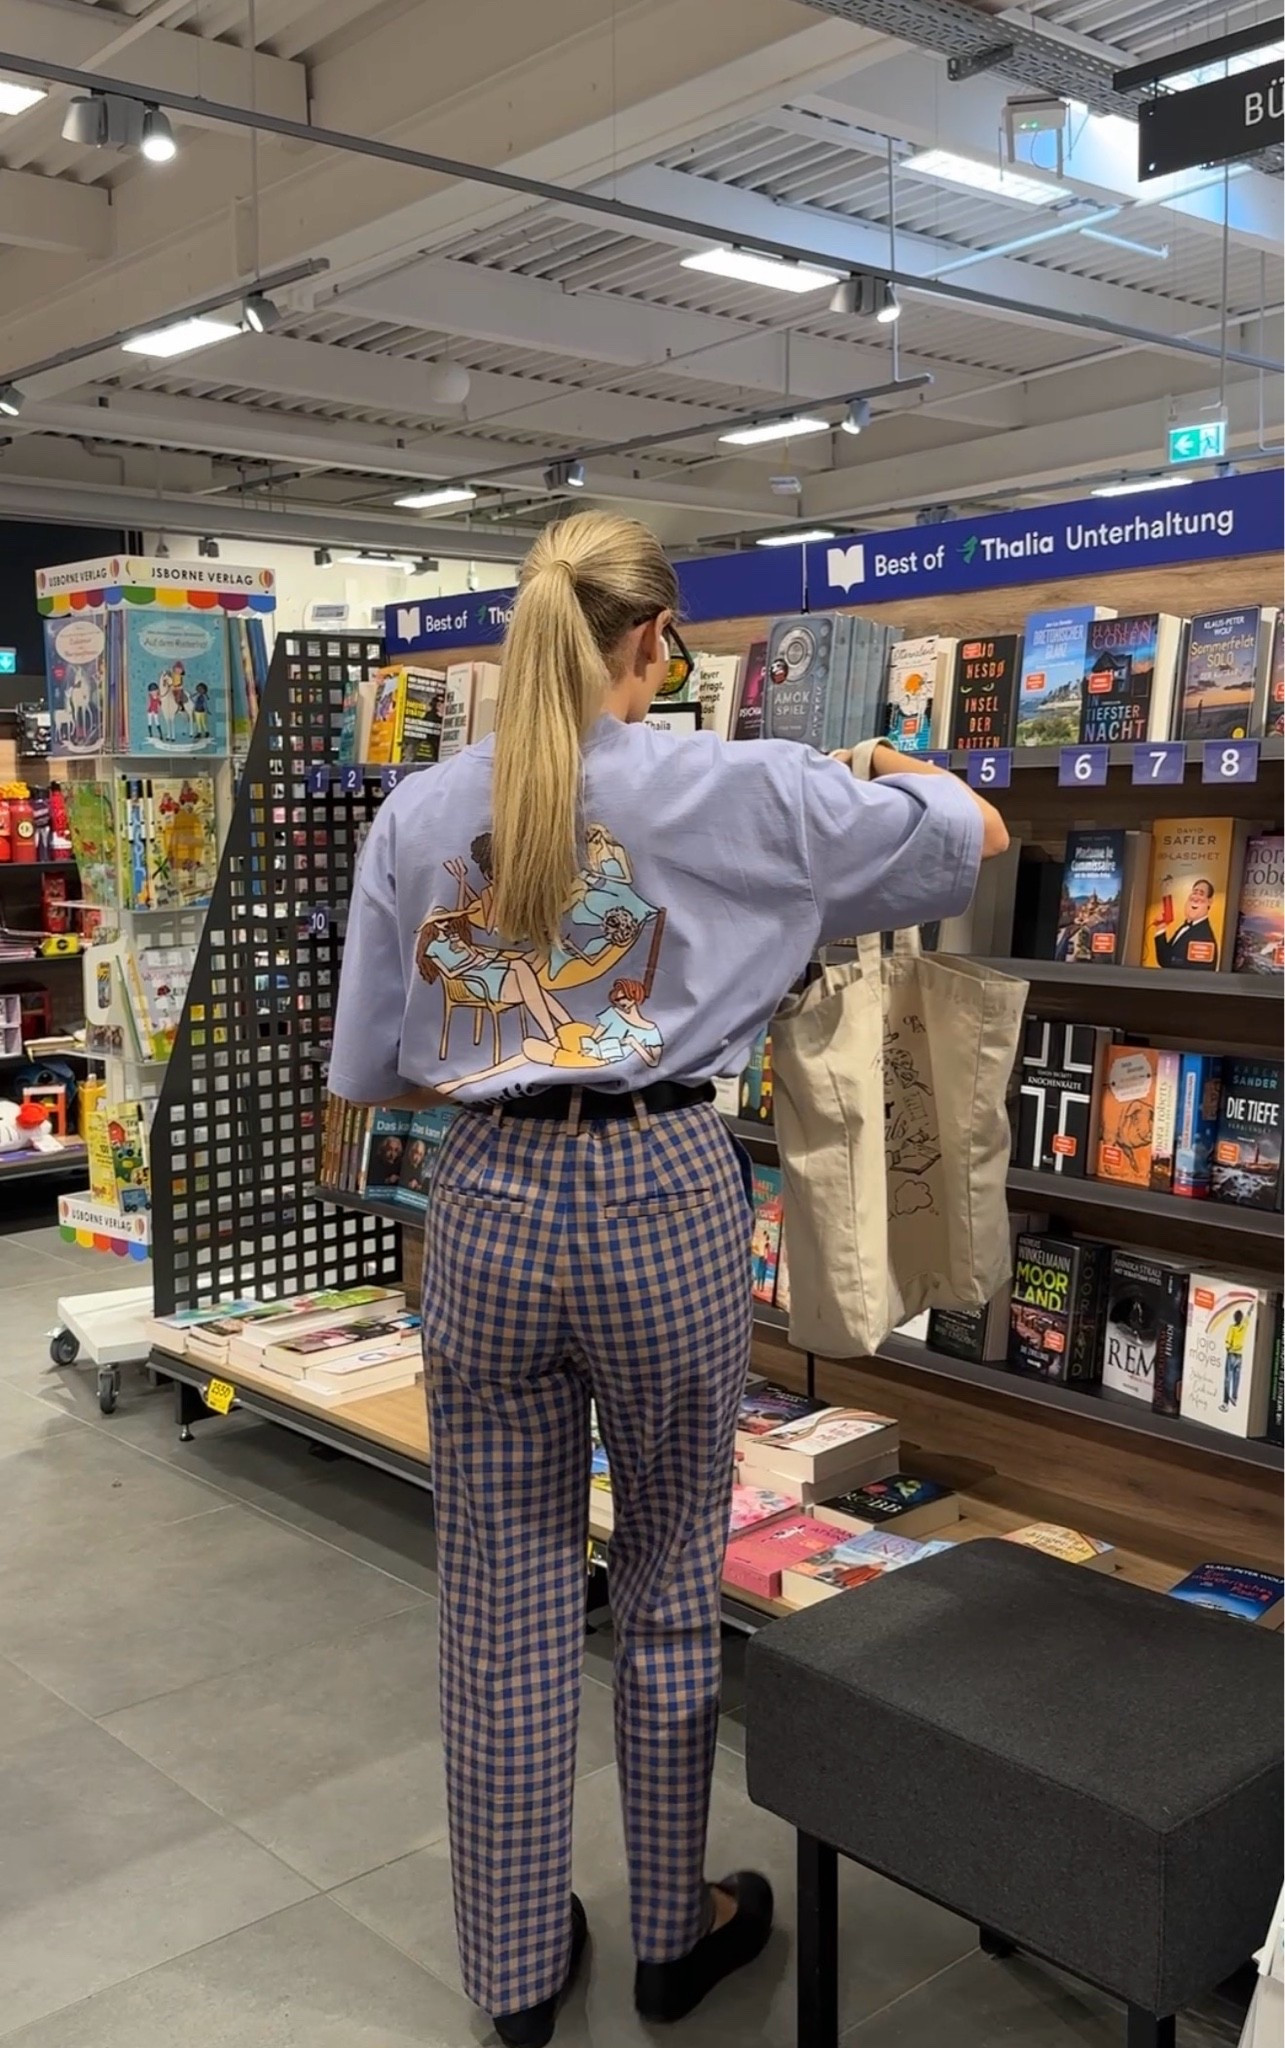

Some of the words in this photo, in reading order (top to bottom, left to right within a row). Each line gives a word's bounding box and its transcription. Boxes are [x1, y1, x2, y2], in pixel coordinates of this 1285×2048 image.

[874, 550, 917, 578] Best
[923, 544, 946, 569] of
[980, 531, 1055, 562] Thalia
[1066, 508, 1234, 552] Unterhaltung
[80, 567, 108, 582] VERLAG
[207, 571, 254, 586] VERLAG
[425, 614, 453, 633] Best
[454, 609, 468, 630] of
[487, 606, 514, 625] Tha
[1092, 619, 1151, 639] HARLAN
[1091, 631, 1151, 650] COBEN
[1214, 626, 1234, 636] WOLF
[1190, 633, 1255, 656] Sommerfeldt
[1207, 650, 1234, 668] SOLO
[700, 670, 720, 680] lever
[774, 690, 810, 705] AMOK
[964, 695, 999, 713] INSEL
[775, 704, 806, 716] SPIEL
[1086, 704, 1141, 722] TIEFSTER
[969, 716, 992, 733] DER
[1084, 719, 1146, 743] NACHT
[957, 736, 1001, 749] RATTEN
[980, 757, 996, 783] 5
[1074, 753, 1093, 780] 6
[1149, 751, 1167, 778] 7
[1220, 748, 1240, 778] 8
[315, 771, 321, 789] 1
[347, 770, 357, 788] 2
[387, 769, 397, 788] 3
[1163, 835, 1217, 846] SAFIER
[1248, 849, 1284, 864] nor
[311, 912, 326, 931] 10
[1028, 1075, 1082, 1091] KNOCHENKÄLTE
[1232, 1074, 1278, 1090] SANDER
[1226, 1096, 1247, 1121] DIE
[1247, 1099, 1281, 1126] TIEFE
[376, 1120, 396, 1132] Das
[411, 1122, 425, 1134] Das
[72, 1209, 103, 1225] USBORNE
[104, 1217, 132, 1232] VERLAG
[1018, 1245, 1072, 1273] WINKELMANN
[1015, 1260, 1069, 1295] MOOR
[1011, 1281, 1064, 1314] LAND
[1196, 1335, 1217, 1354] jojo
[1107, 1336, 1156, 1377] REM
[1188, 1347, 1222, 1369] moyes
